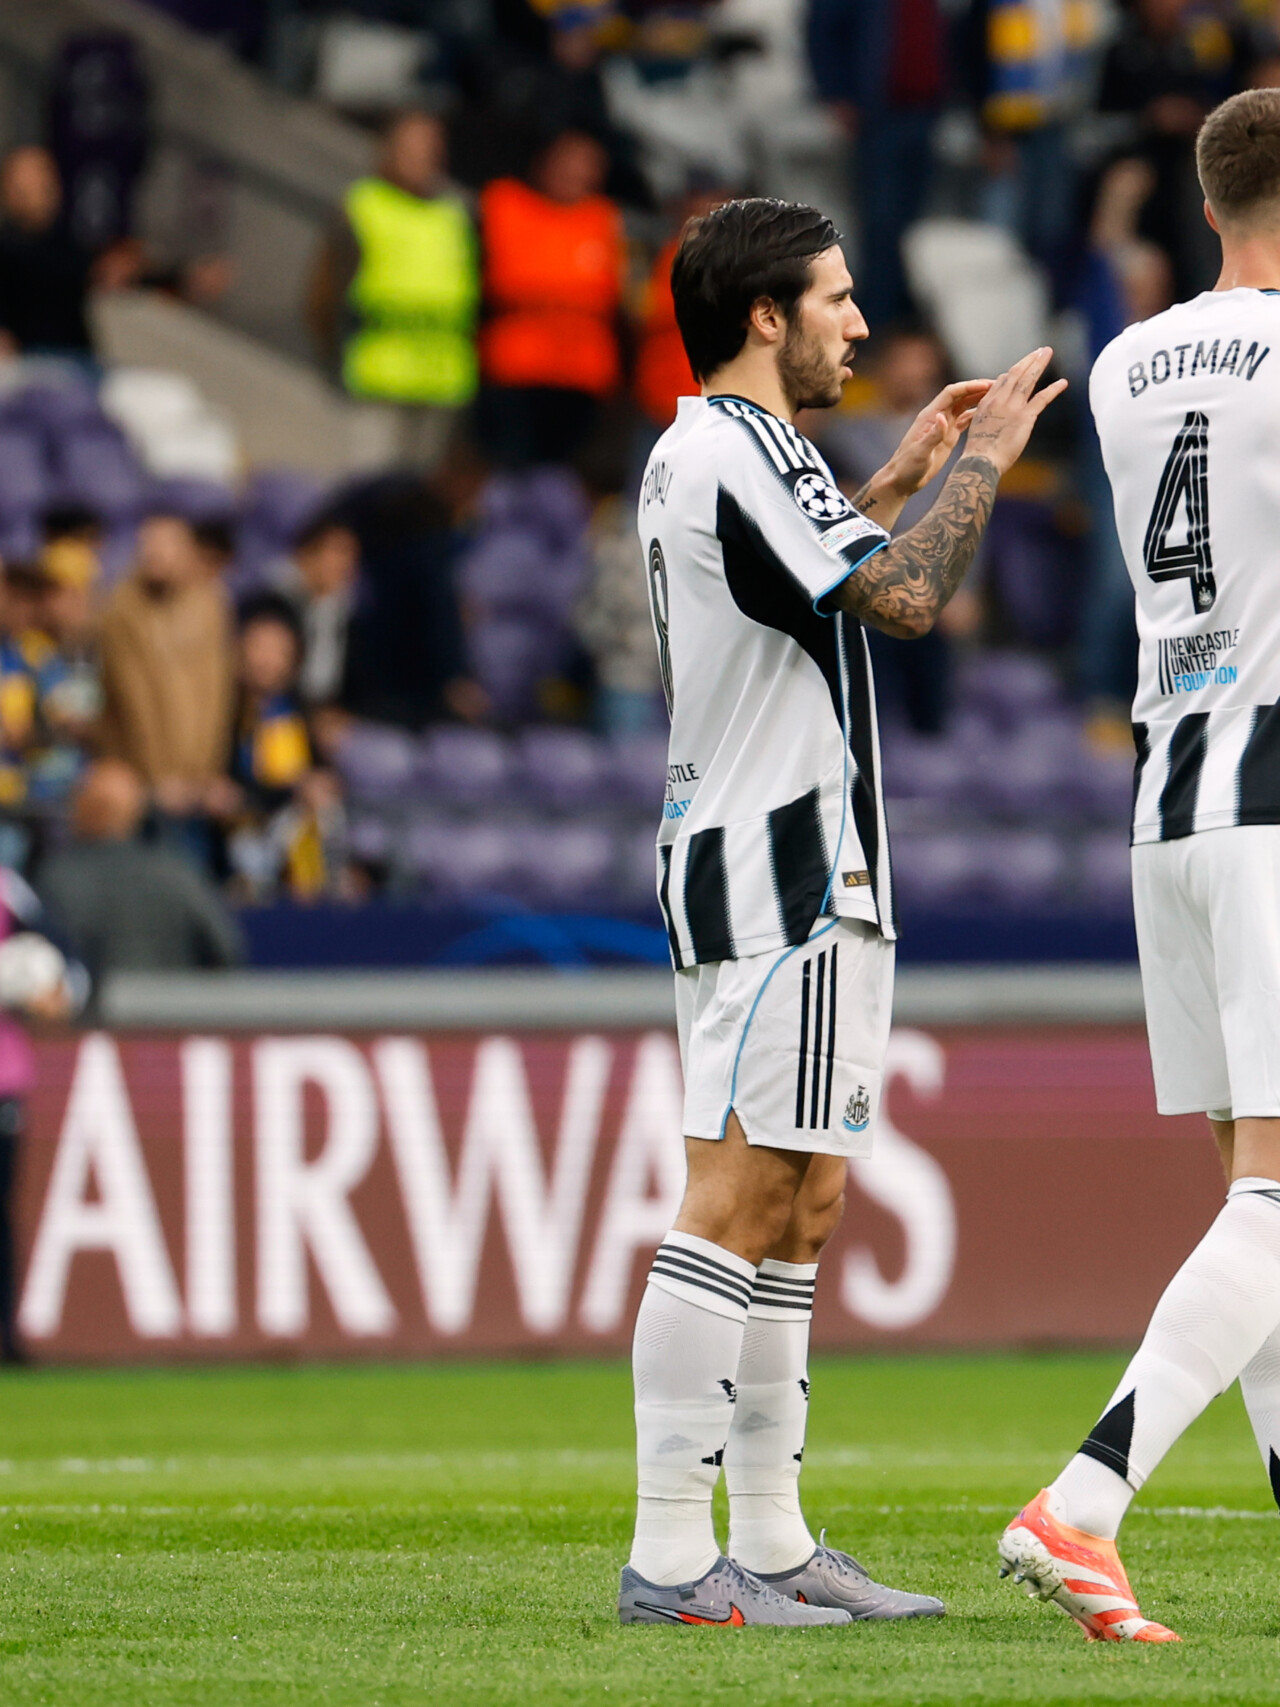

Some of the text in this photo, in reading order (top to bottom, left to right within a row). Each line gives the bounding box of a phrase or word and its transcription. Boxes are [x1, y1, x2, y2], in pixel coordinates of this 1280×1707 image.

[1128, 338, 1270, 398] BOTMAN
[1143, 411, 1217, 615] 4
[1169, 628, 1240, 657] NEWCASTLE
[1170, 652, 1217, 676] UNITED
[17, 1028, 956, 1341] AIRWAS
